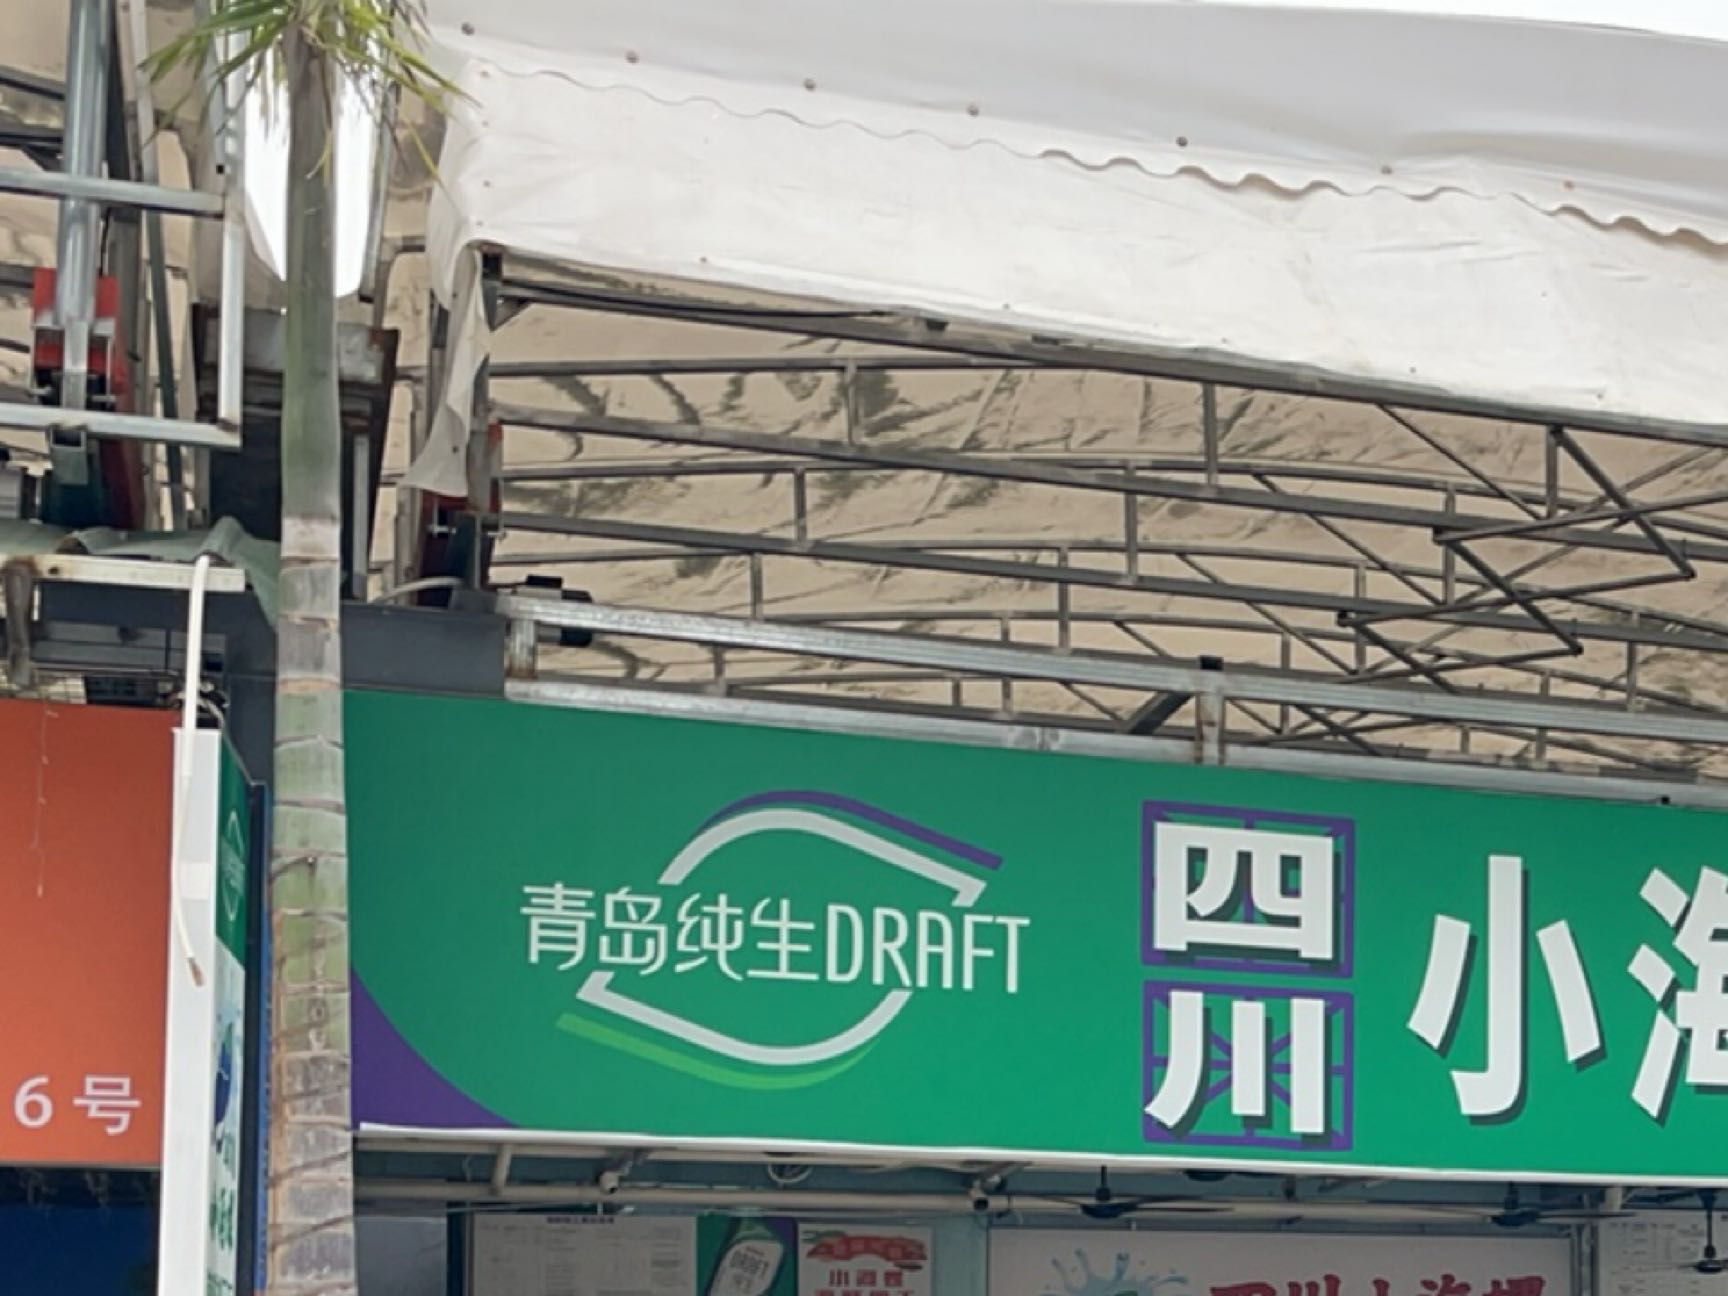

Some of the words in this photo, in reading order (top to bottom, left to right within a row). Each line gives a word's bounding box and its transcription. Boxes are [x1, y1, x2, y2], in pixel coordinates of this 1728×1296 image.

[520, 882, 1030, 994] 青岛纯生DRAFT
[1145, 821, 1334, 1134] 四川
[14, 1073, 142, 1136] 6号
